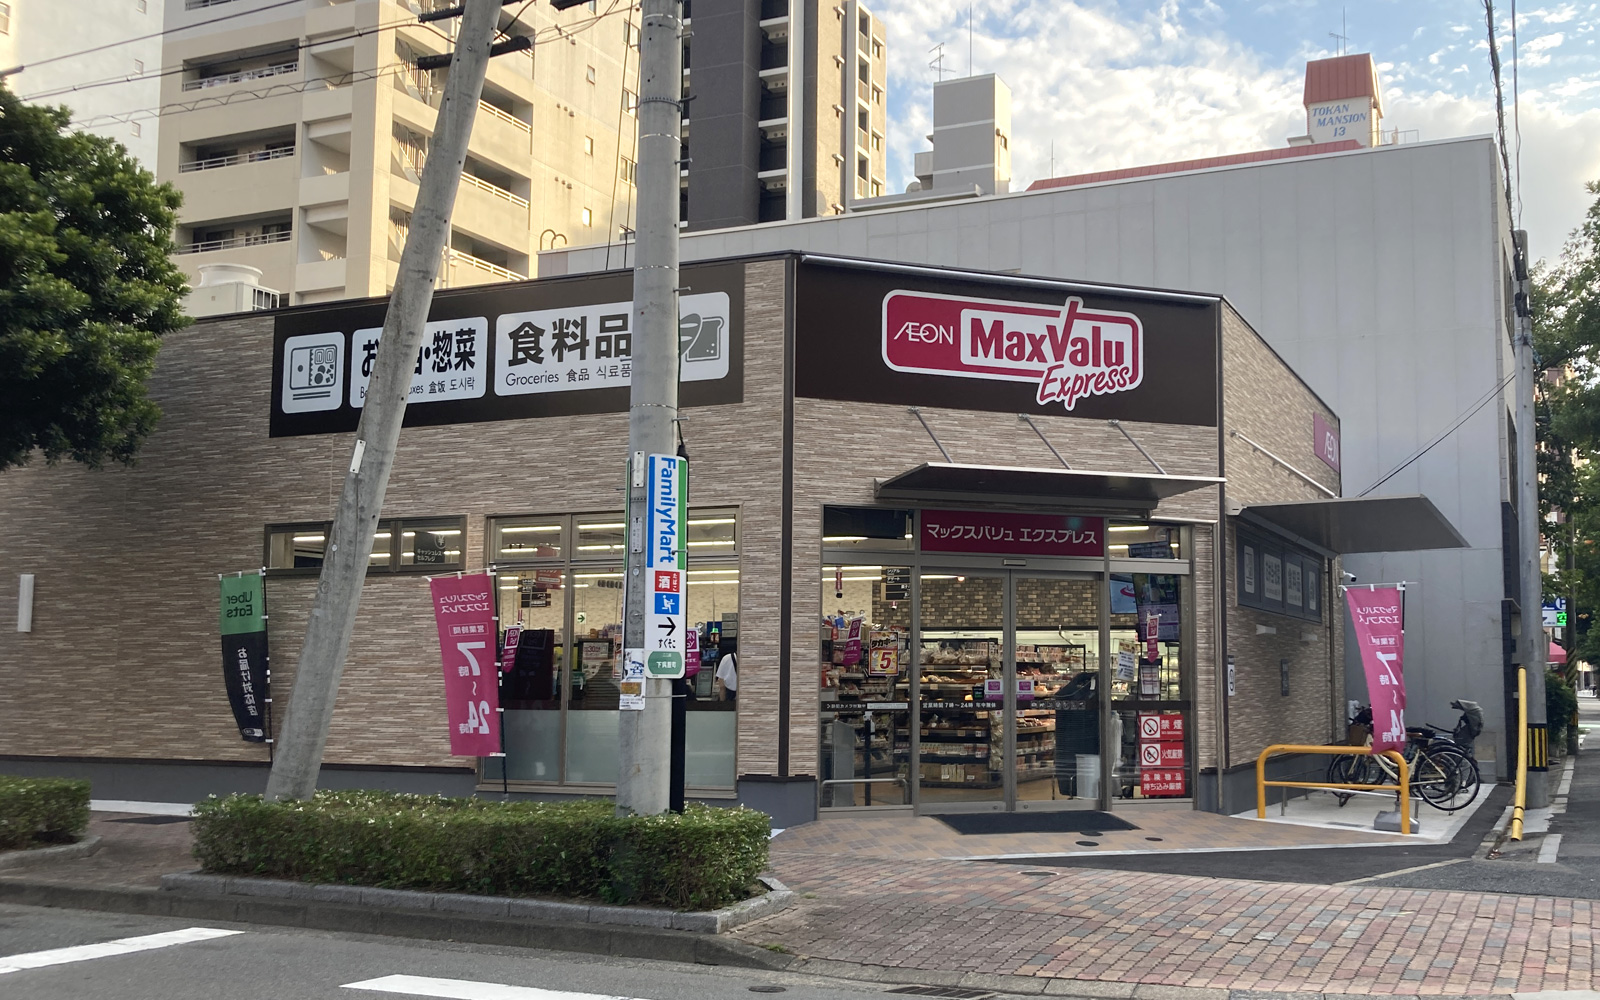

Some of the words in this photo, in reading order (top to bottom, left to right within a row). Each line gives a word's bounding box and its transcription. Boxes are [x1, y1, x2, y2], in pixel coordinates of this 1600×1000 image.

[1312, 103, 1350, 117] TOKAN
[1316, 112, 1368, 127] MANSION
[1333, 126, 1346, 137] 13
[507, 312, 632, 368] 食料品
[970, 300, 1125, 368] MaxValu
[449, 376, 476, 391] 도시락
[505, 370, 560, 387] Groceries
[566, 368, 590, 383] 食品
[596, 363, 632, 380] 식료품
[1039, 363, 1130, 408] Express
[655, 456, 677, 563] FamilyMart
[926, 524, 1015, 542] マックスバリュ
[1019, 527, 1097, 544] エクスプレス
[658, 575, 671, 590] 酒
[880, 651, 893, 669] 5
[1143, 782, 1182, 791] 持ち込み厳禁
